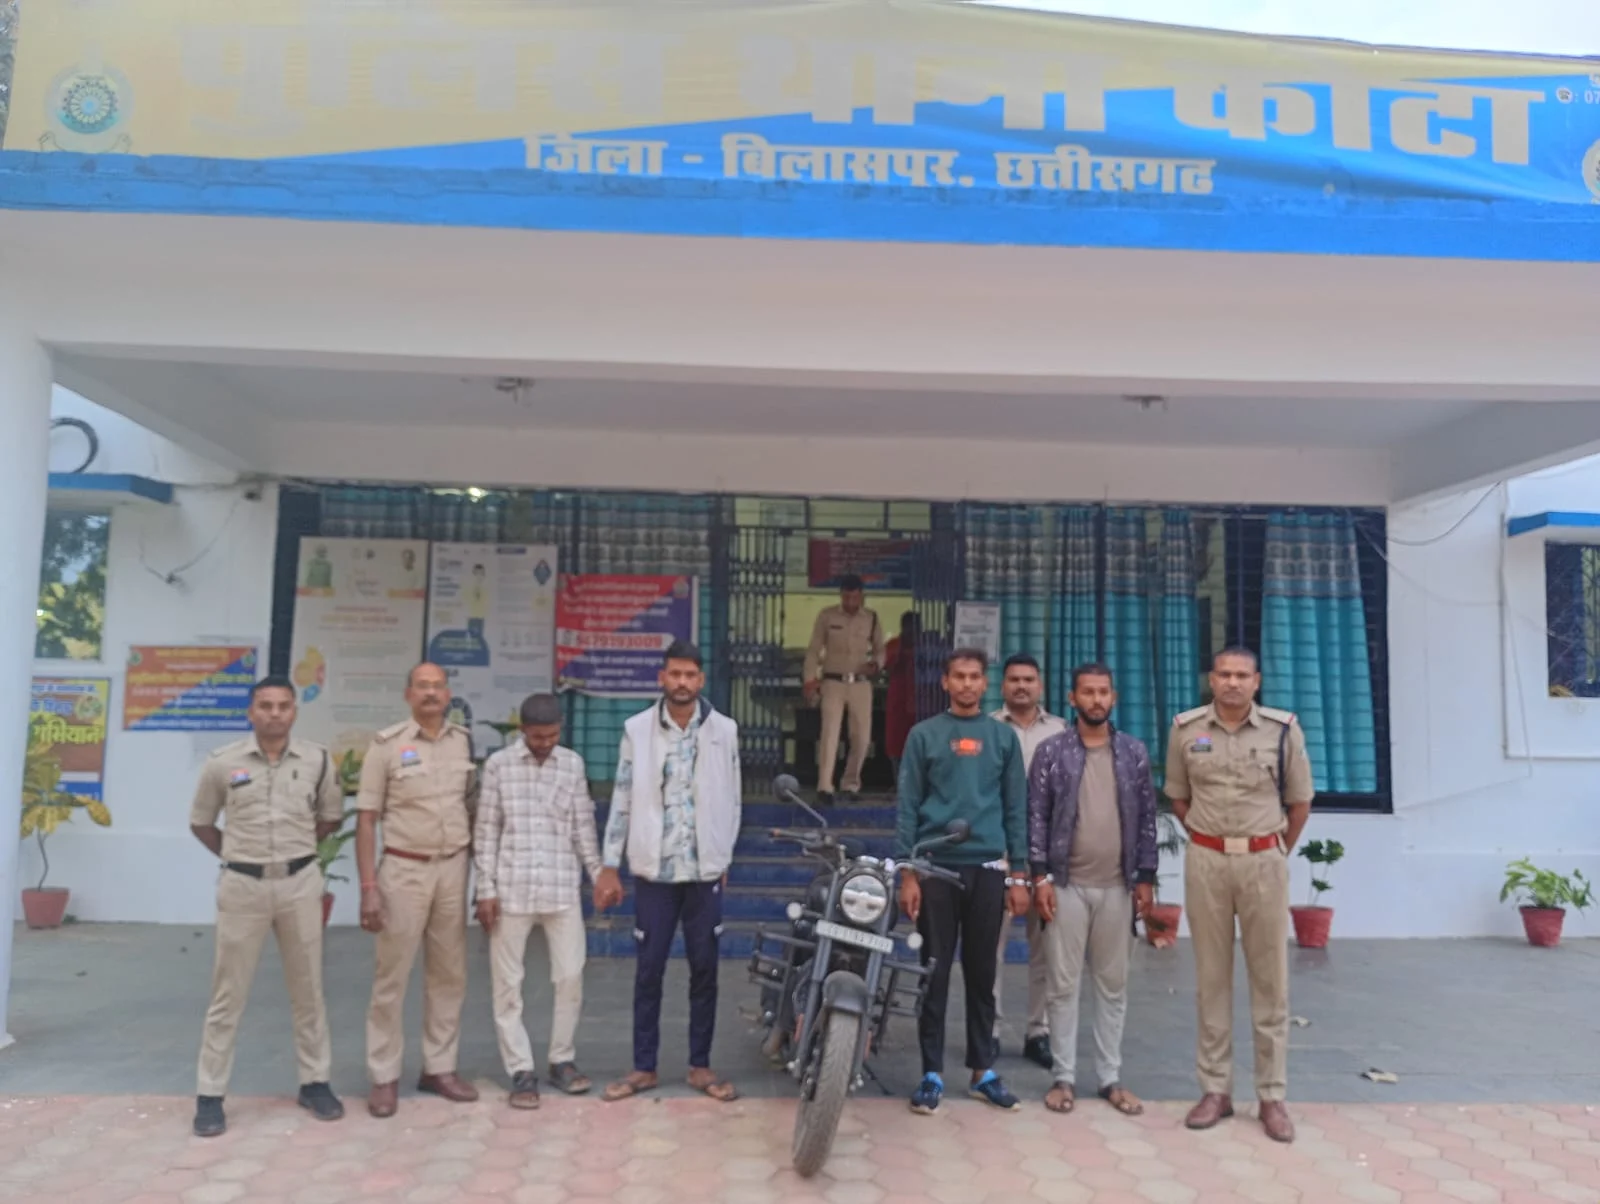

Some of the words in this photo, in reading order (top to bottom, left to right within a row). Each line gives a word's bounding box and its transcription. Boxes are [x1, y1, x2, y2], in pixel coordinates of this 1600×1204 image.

[178, 3, 684, 139] पुलिस
[738, 33, 1122, 132] थाना
[524, 132, 668, 175] जिला
